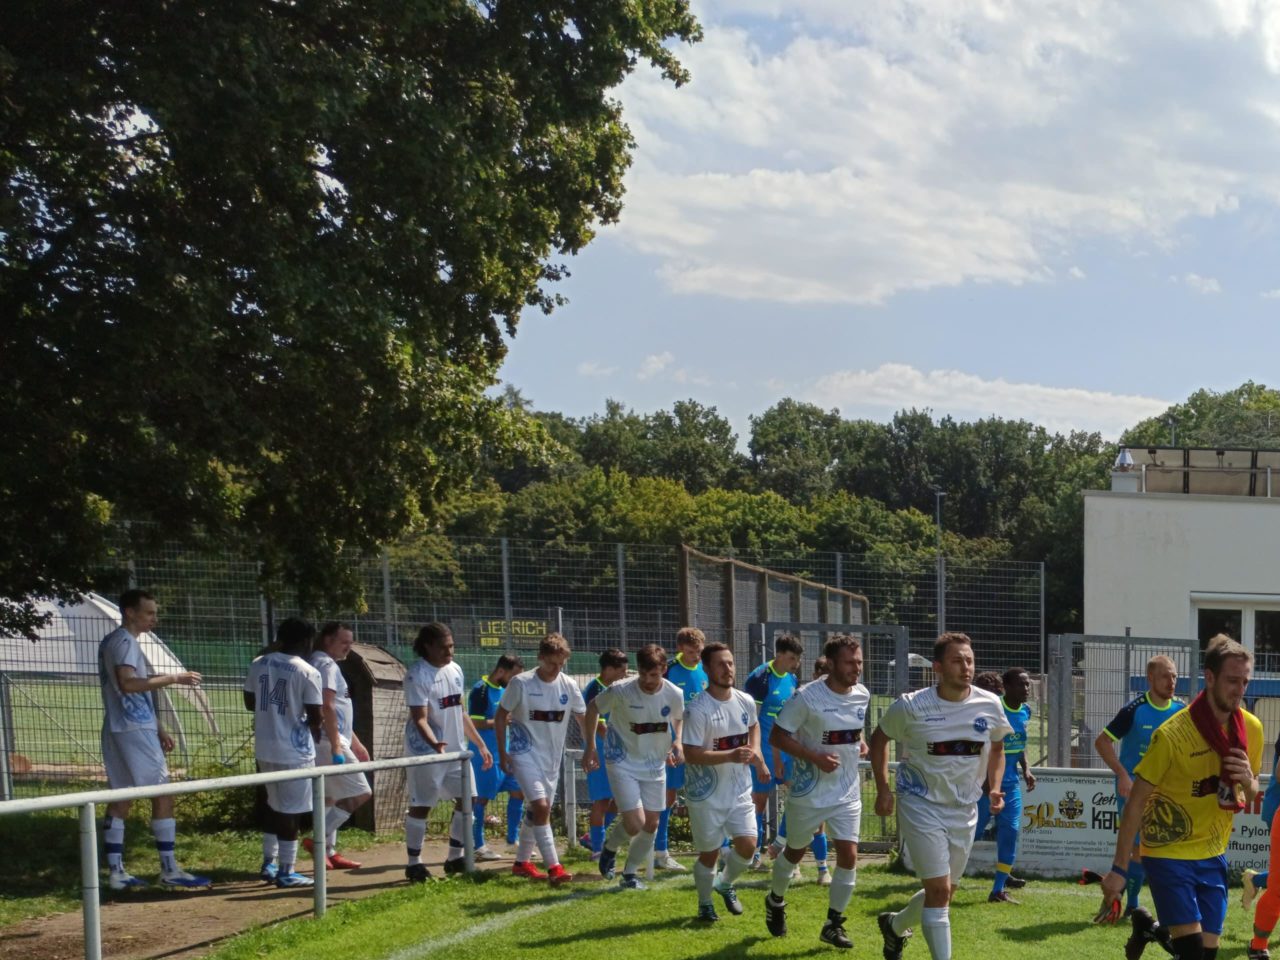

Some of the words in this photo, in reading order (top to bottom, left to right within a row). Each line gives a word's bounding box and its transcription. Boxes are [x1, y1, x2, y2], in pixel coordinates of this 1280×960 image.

[259, 674, 288, 716] 14
[1023, 801, 1055, 830] 50
[1241, 825, 1271, 838] Pylon
[1228, 840, 1271, 854] iftungen
